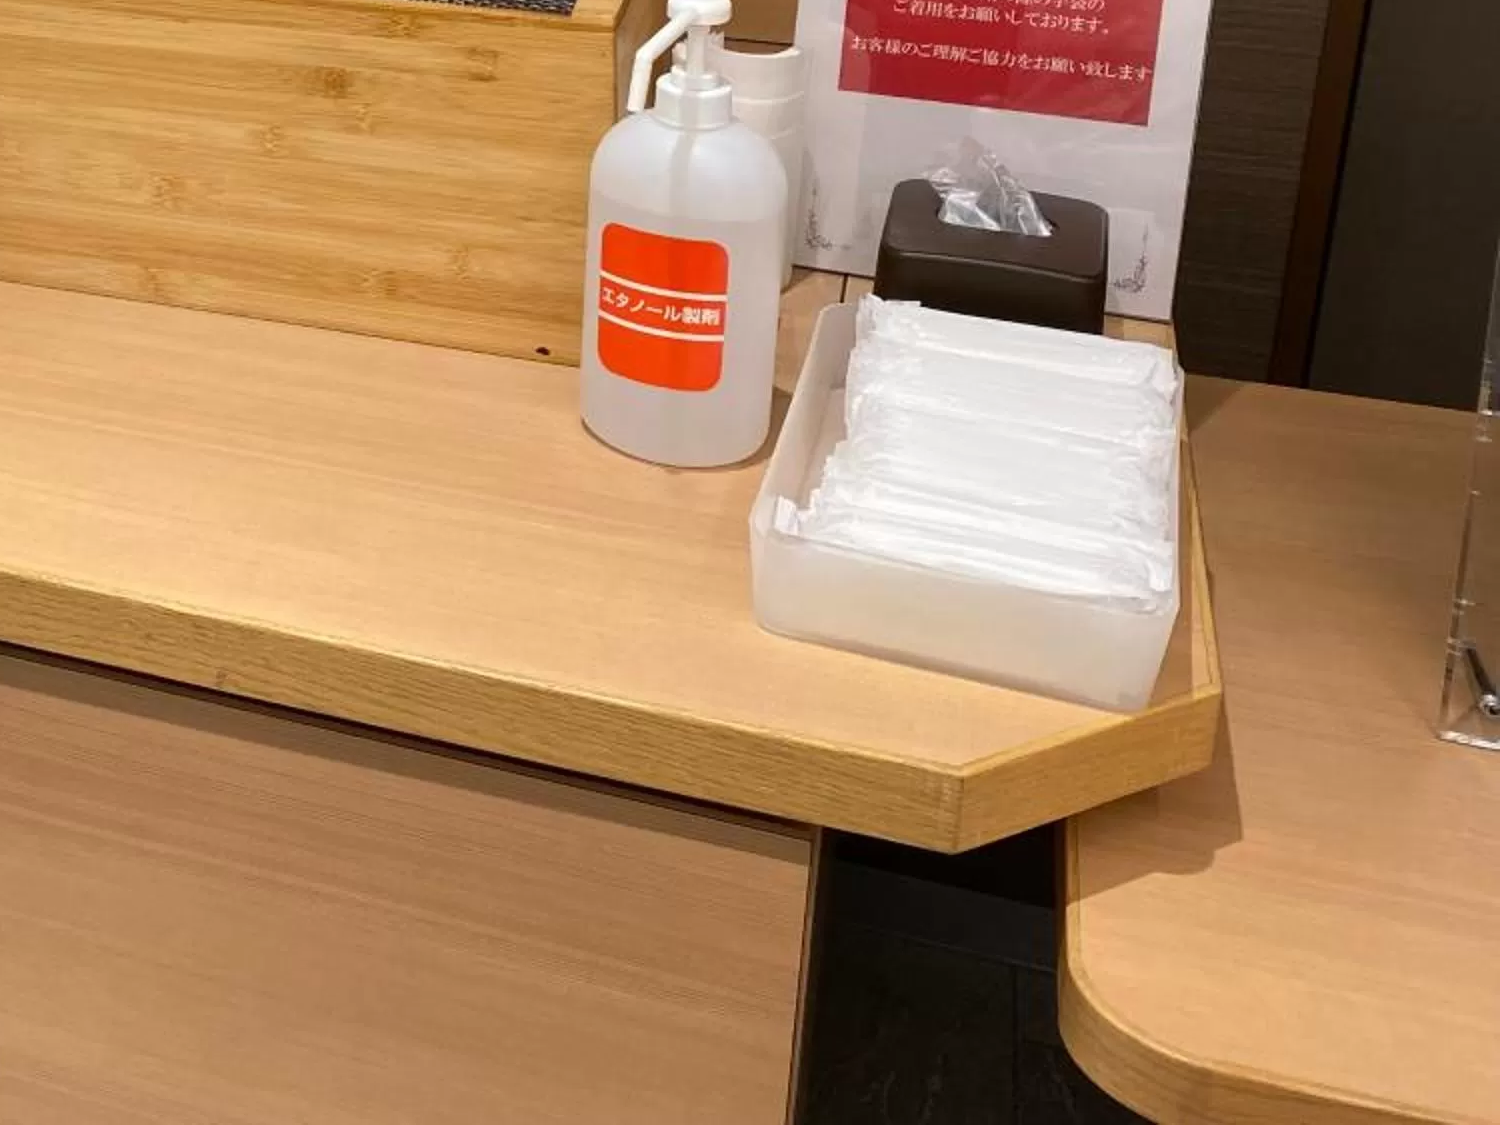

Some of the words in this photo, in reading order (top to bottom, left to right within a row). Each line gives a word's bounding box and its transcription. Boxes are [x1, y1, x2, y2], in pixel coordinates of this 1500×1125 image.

[602, 287, 720, 326] エタノール製剤
